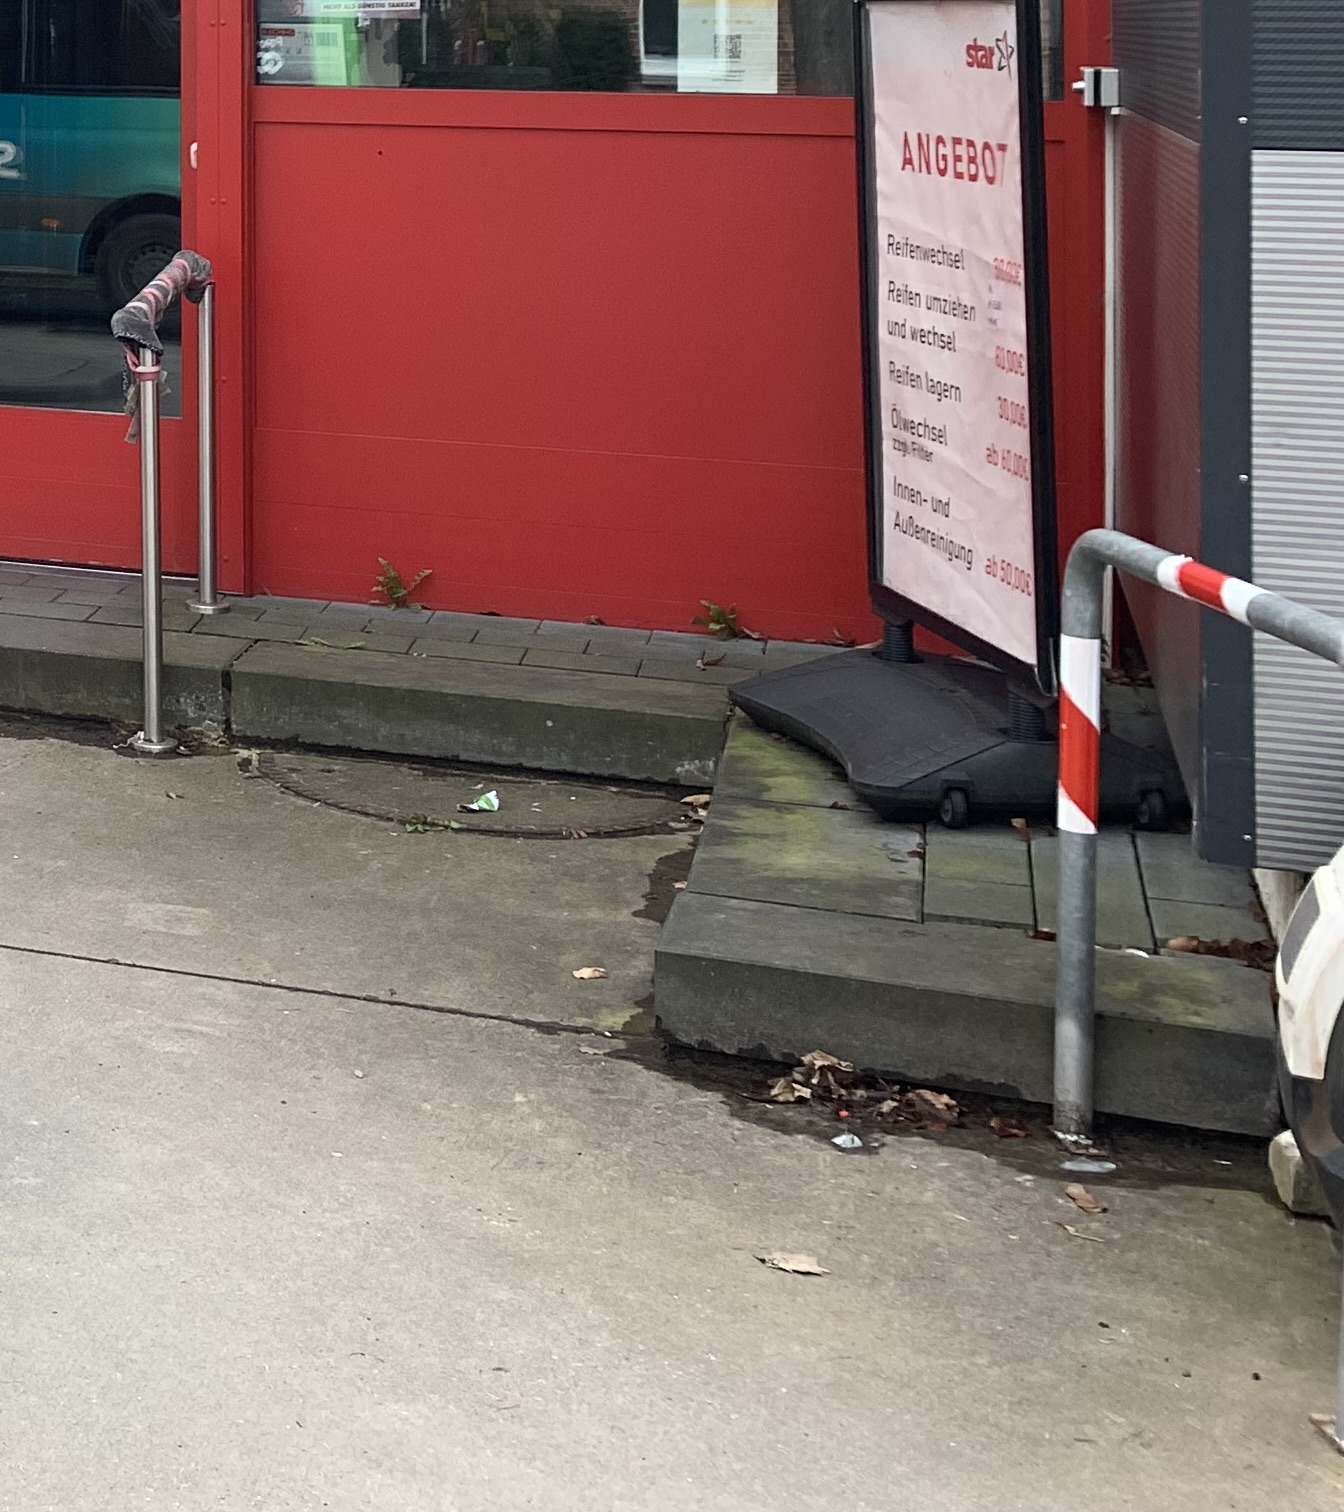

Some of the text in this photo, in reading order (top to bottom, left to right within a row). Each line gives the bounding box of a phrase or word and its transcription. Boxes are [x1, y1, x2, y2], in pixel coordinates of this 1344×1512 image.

[965, 37, 996, 71] star
[900, 130, 1008, 188] ANGEBOT
[886, 233, 966, 271] Reifenwechsel
[886, 279, 922, 309] Reifen
[925, 292, 977, 323] umziehen
[886, 318, 907, 340] und
[910, 325, 957, 353] wechsel
[888, 360, 923, 391] Reifen
[924, 370, 962, 403] lagern
[890, 402, 949, 447] Ölwechsel
[985, 442, 999, 467] ab
[892, 474, 951, 519] Innen- und
[892, 509, 974, 571] Außenreinigung
[984, 554, 999, 578] ab
